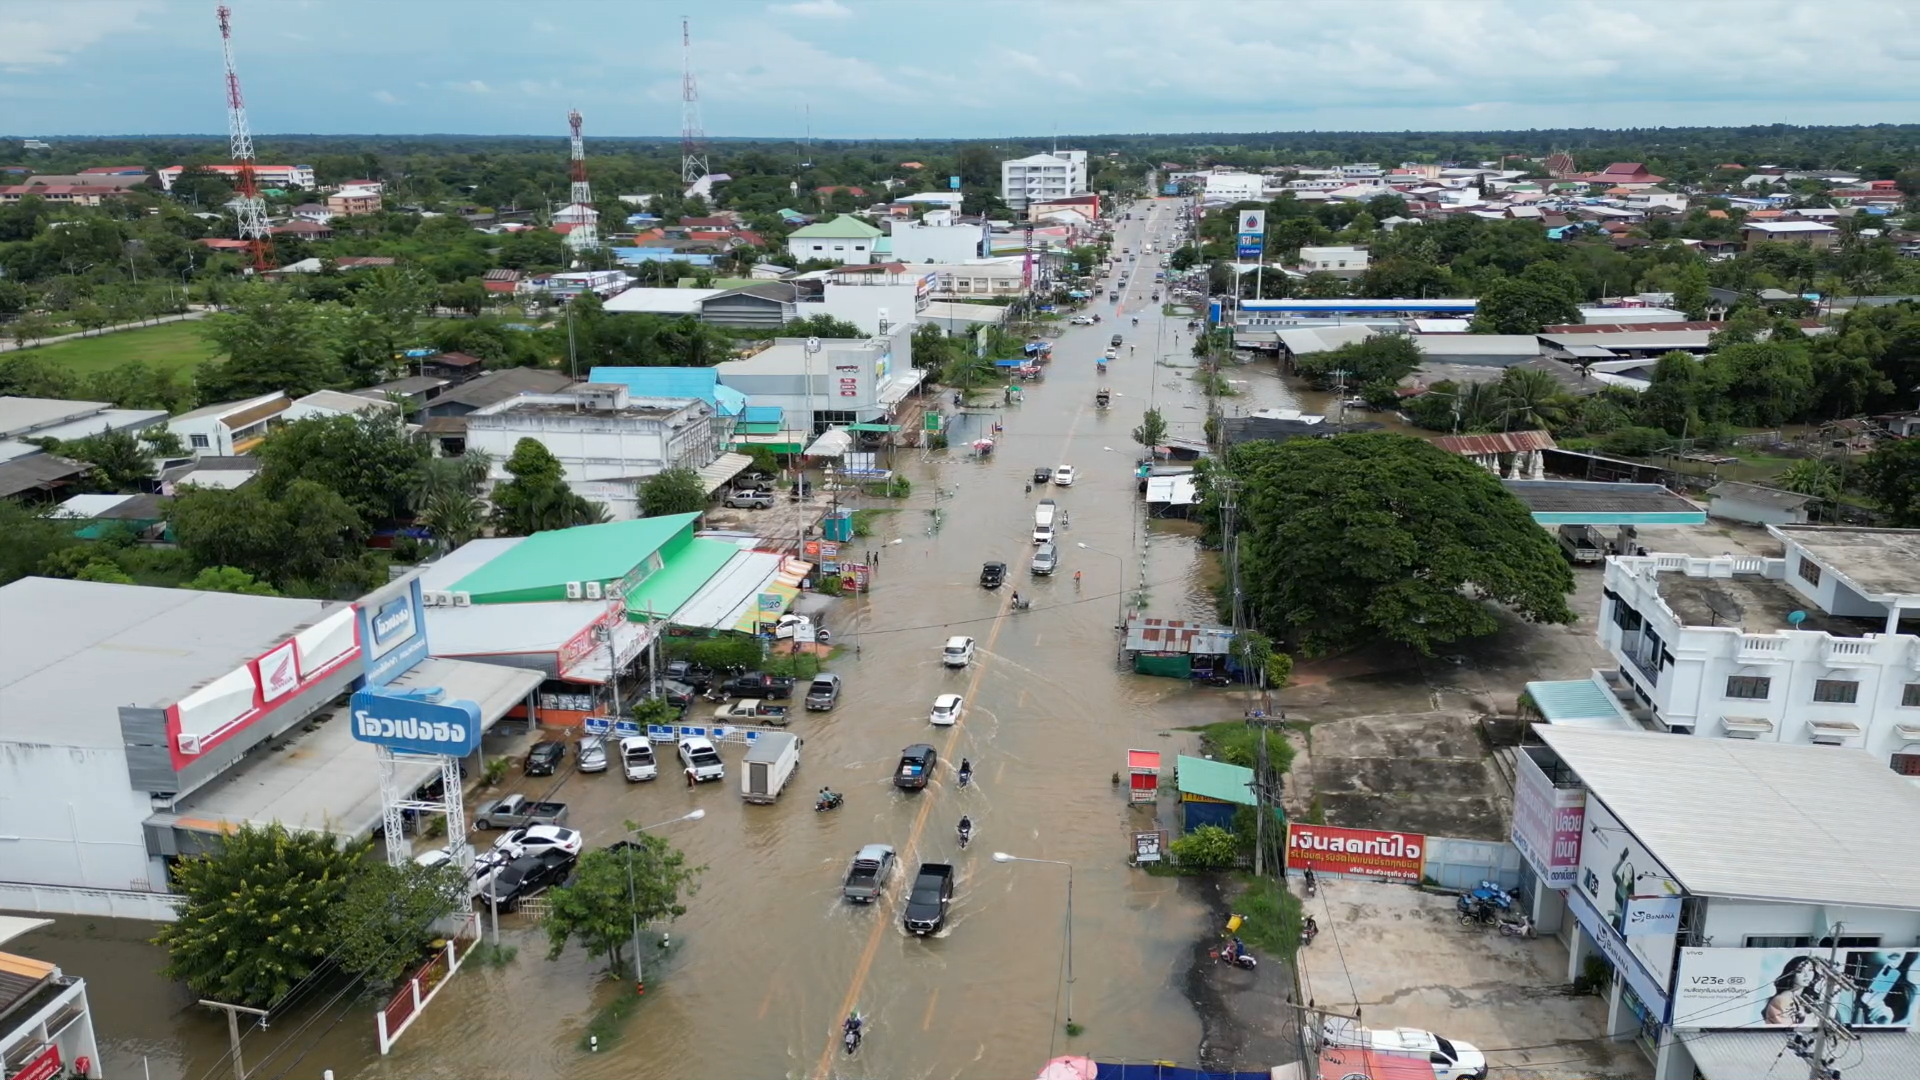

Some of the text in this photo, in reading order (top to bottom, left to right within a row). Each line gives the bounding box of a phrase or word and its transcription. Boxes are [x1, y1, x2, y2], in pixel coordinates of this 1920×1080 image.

[355, 710, 466, 743] โอวเปงฮง
[1555, 809, 1582, 832] ปล่อย
[1291, 831, 1420, 859] เงินสดทันใจ
[1555, 833, 1579, 864] เงินกู้
[1403, 871, 1418, 879] จำกัด
[1692, 976, 1724, 985] V23e
